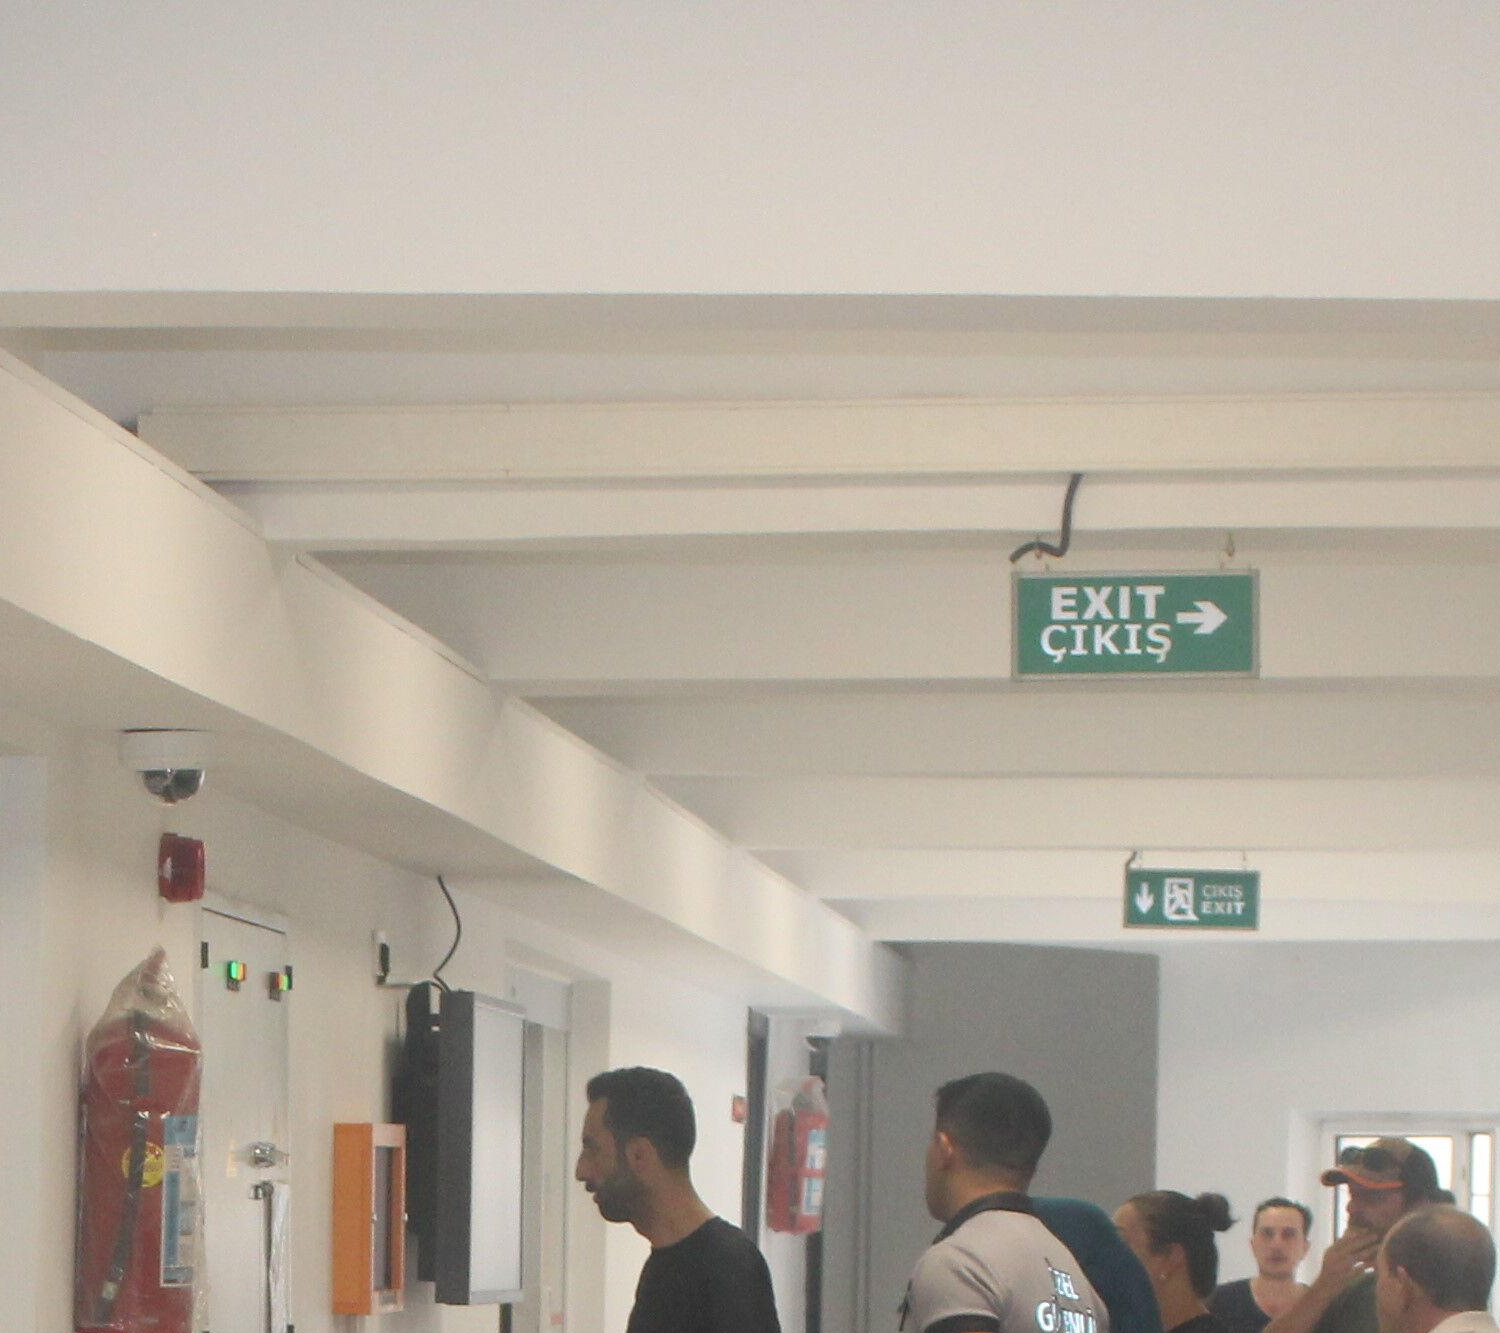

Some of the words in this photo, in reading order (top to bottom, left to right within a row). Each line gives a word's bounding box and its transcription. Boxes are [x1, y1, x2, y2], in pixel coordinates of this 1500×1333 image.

[1050, 584, 1166, 621] EXIT
[1040, 623, 1172, 663] ÇIKIŞ
[1202, 901, 1246, 915] EXIT
